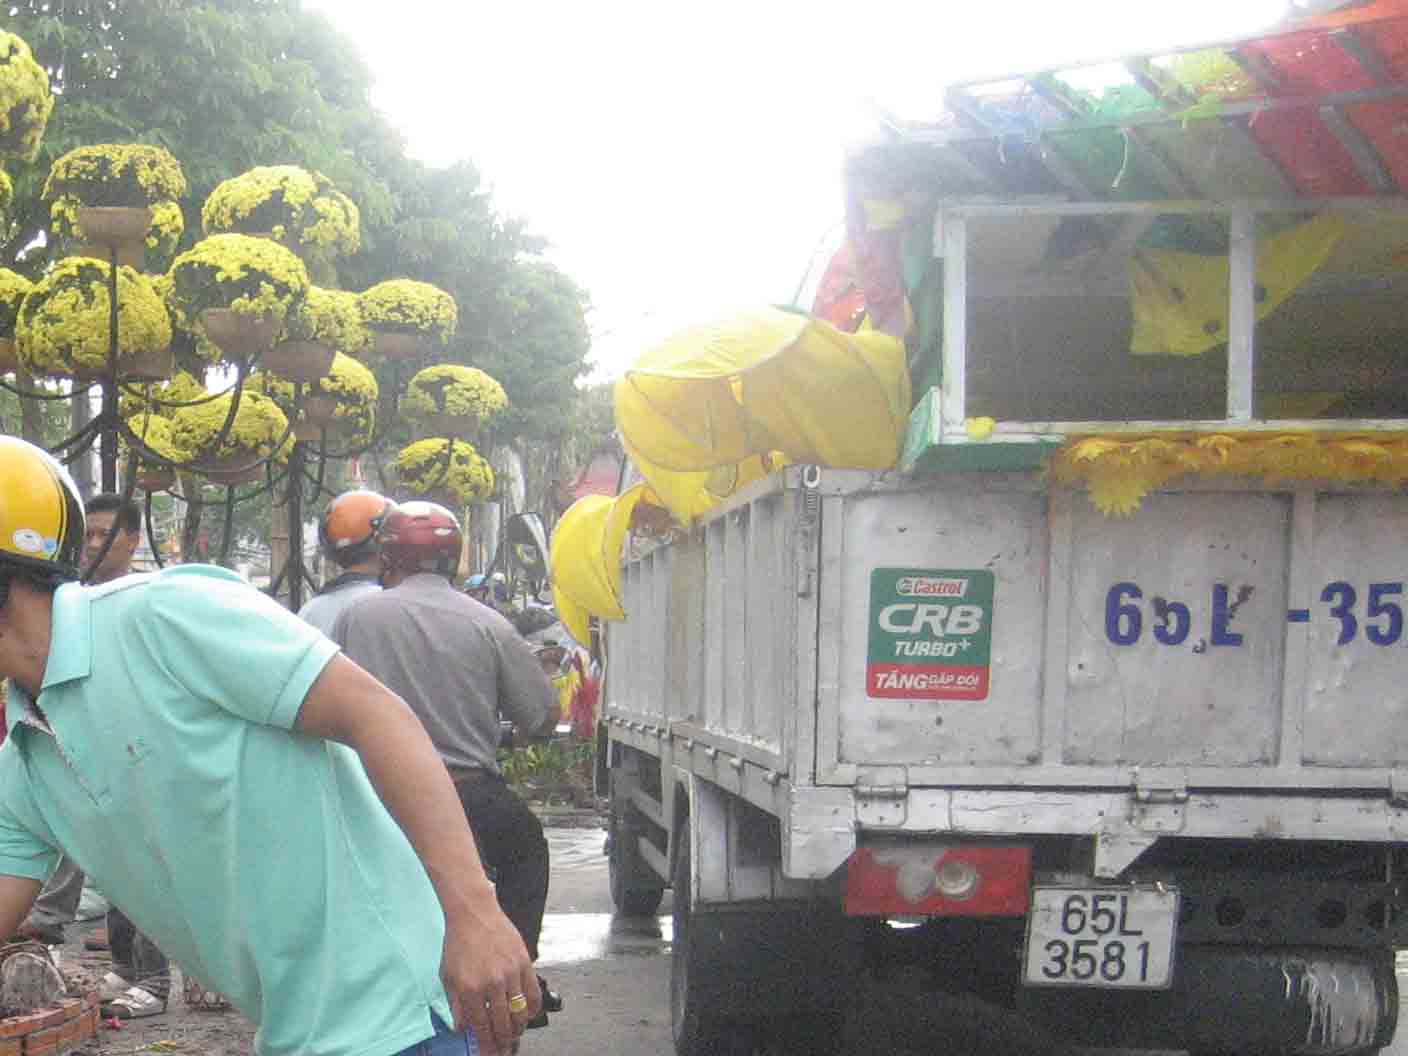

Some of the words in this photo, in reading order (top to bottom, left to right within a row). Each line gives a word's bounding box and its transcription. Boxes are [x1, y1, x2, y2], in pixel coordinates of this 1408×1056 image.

[878, 603, 983, 637] CRB
[1061, 894, 1143, 936] 65L
[1041, 939, 1150, 982] 3581
